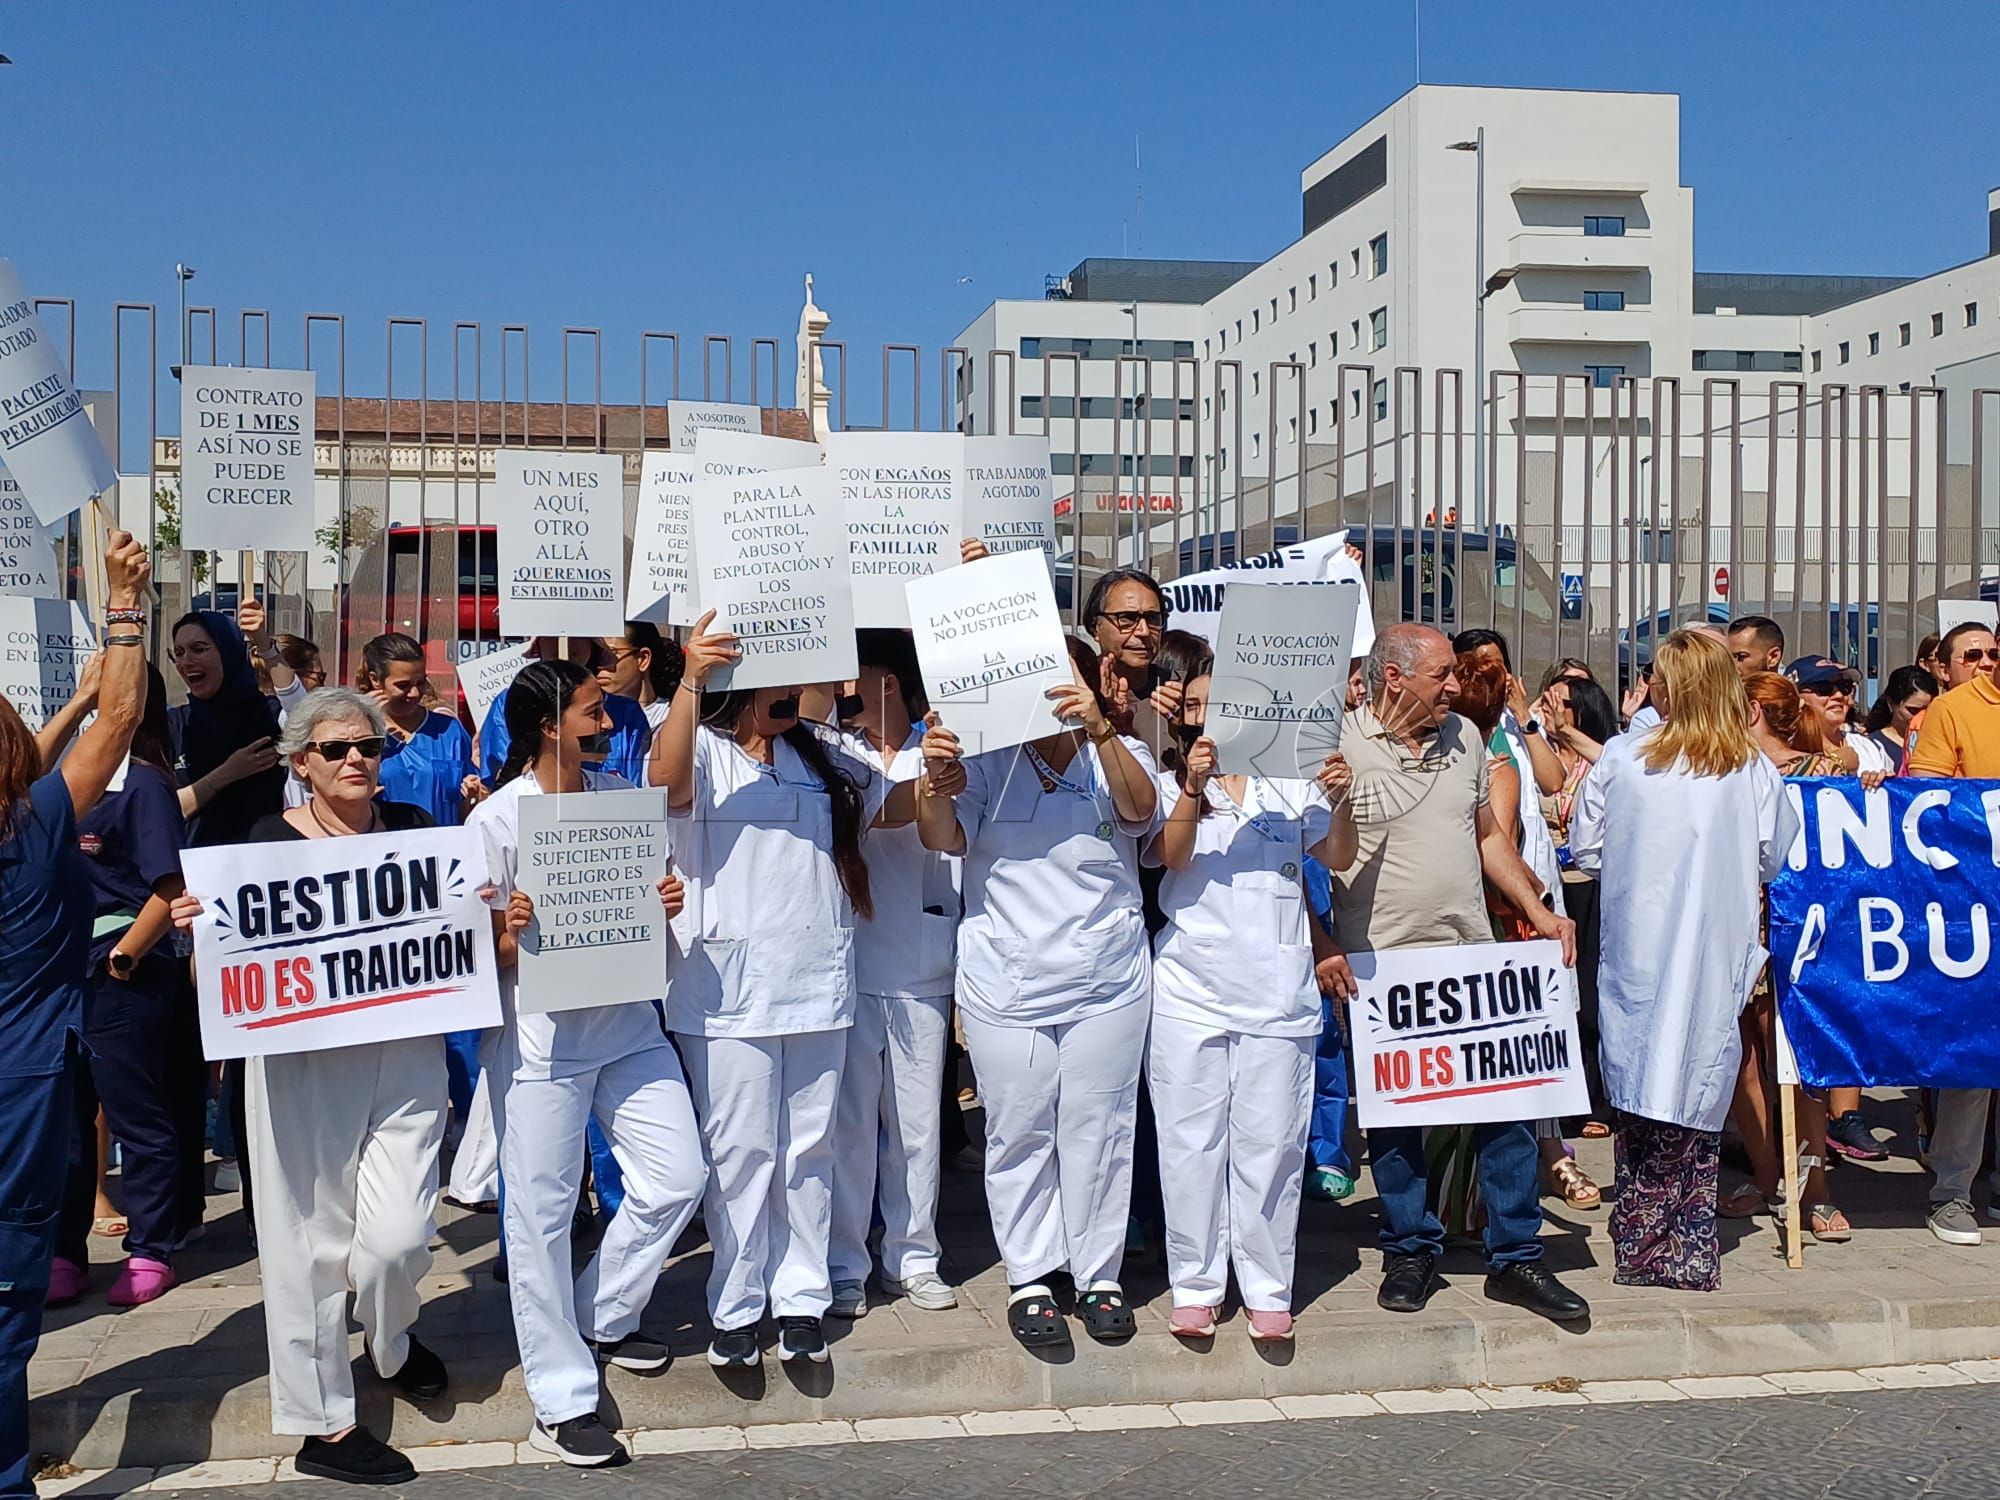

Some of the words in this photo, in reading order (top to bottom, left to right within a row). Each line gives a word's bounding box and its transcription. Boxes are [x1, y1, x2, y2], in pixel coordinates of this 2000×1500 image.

[0, 327, 37, 359] OTADO
[1, 373, 63, 416] PACIENTE
[196, 387, 303, 407] CONTRATO
[0, 393, 80, 446] PERJUDICADO
[199, 411, 230, 429] DE
[236, 413, 244, 429] 1
[253, 414, 300, 431] MES
[687, 412, 695, 422] A
[696, 412, 746, 425] NOSOTROS
[683, 425, 699, 435] NO
[197, 433, 232, 454] ASÍ
[238, 438, 271, 455] NO
[277, 439, 302, 456] SE
[680, 437, 696, 447] LA
[214, 462, 286, 481] PUEDE
[704, 462, 733, 476] CON
[876, 466, 951, 481] ENGAÑOS
[966, 467, 1047, 481] TRABAJADOR
[523, 470, 552, 486] UN
[558, 471, 598, 488] MES
[206, 487, 294, 506] CRECER
[658, 493, 690, 506] MIEN
[733, 487, 776, 504] PARA
[780, 484, 802, 499] LA
[863, 486, 893, 499] LAS
[897, 486, 952, 500] HORAS
[981, 485, 1040, 499] AGOTADO
[533, 492, 589, 515] AQUÍ,
[884, 504, 905, 518] LA
[13, 516, 33, 530] DE
[723, 503, 816, 525] PLANTILLA
[534, 519, 589, 536] OTRO
[657, 522, 688, 535] PRES
[731, 523, 809, 542] CONTROL,
[846, 520, 950, 535] ONCILIACIÓN
[984, 521, 1045, 535] PACIENTE
[536, 540, 589, 561] ALLÁ
[647, 551, 664, 562] LA
[738, 542, 791, 559] ABUSO
[794, 540, 805, 553] Y
[849, 540, 938, 555] FAMILIAR
[513, 566, 611, 582] ¡QUEREMOS
[713, 555, 820, 580] EXPLOTACIÓN
[823, 556, 834, 569] Y
[851, 560, 935, 575] EMPEORA
[36, 572, 47, 585] A
[652, 580, 669, 592] LA
[759, 578, 791, 594] LOS
[511, 585, 614, 599] ESTABILIDAD!
[727, 595, 826, 617] DESPACHOS
[930, 613, 951, 628] LA
[954, 591, 1037, 620] VOCACIÓN
[815, 615, 827, 629] Y
[933, 627, 957, 643] NO
[961, 608, 1039, 635] JUSTIFICA
[8, 631, 40, 645] CON
[46, 634, 108, 649] ENGA
[732, 632, 828, 656] DIVERSIÓN
[1236, 633, 1257, 647] LA
[1262, 632, 1340, 648] VOCACIÓN
[6, 649, 28, 662] EN
[33, 650, 64, 665] LAS
[487, 657, 528, 675] NOSOT
[983, 651, 1006, 664] LA
[1235, 651, 1259, 665] NO
[1262, 653, 1336, 667] JUSTIFICA
[54, 669, 75, 682] LA
[939, 653, 1057, 695] EXPLOTACIÓN
[478, 678, 501, 693] NOS
[1272, 690, 1293, 702] LA
[1221, 703, 1335, 719] EXPLOTACIÓN
[533, 830, 563, 846] SIN
[568, 823, 655, 844] PERSONAL
[532, 846, 633, 867] SUFICIENTE
[636, 844, 656, 859] EL
[546, 867, 620, 887] PELIGRO
[624, 865, 643, 880] ES
[236, 851, 441, 941] GESTIÓN
[539, 886, 635, 908] INMINENTE
[638, 884, 650, 898] Y
[555, 911, 578, 927] LO
[582, 906, 635, 924] SUFRE
[538, 934, 560, 948] EL
[565, 924, 651, 946] PACIENTE
[220, 962, 266, 1017] NO
[274, 956, 316, 1010] ES
[320, 923, 477, 1000] TRAICIÓN
[1387, 960, 1544, 1031] GESTIÓN
[1373, 1050, 1411, 1093] NO
[1420, 1045, 1455, 1088] ES
[1460, 1024, 1571, 1083] TRAICIÓN
